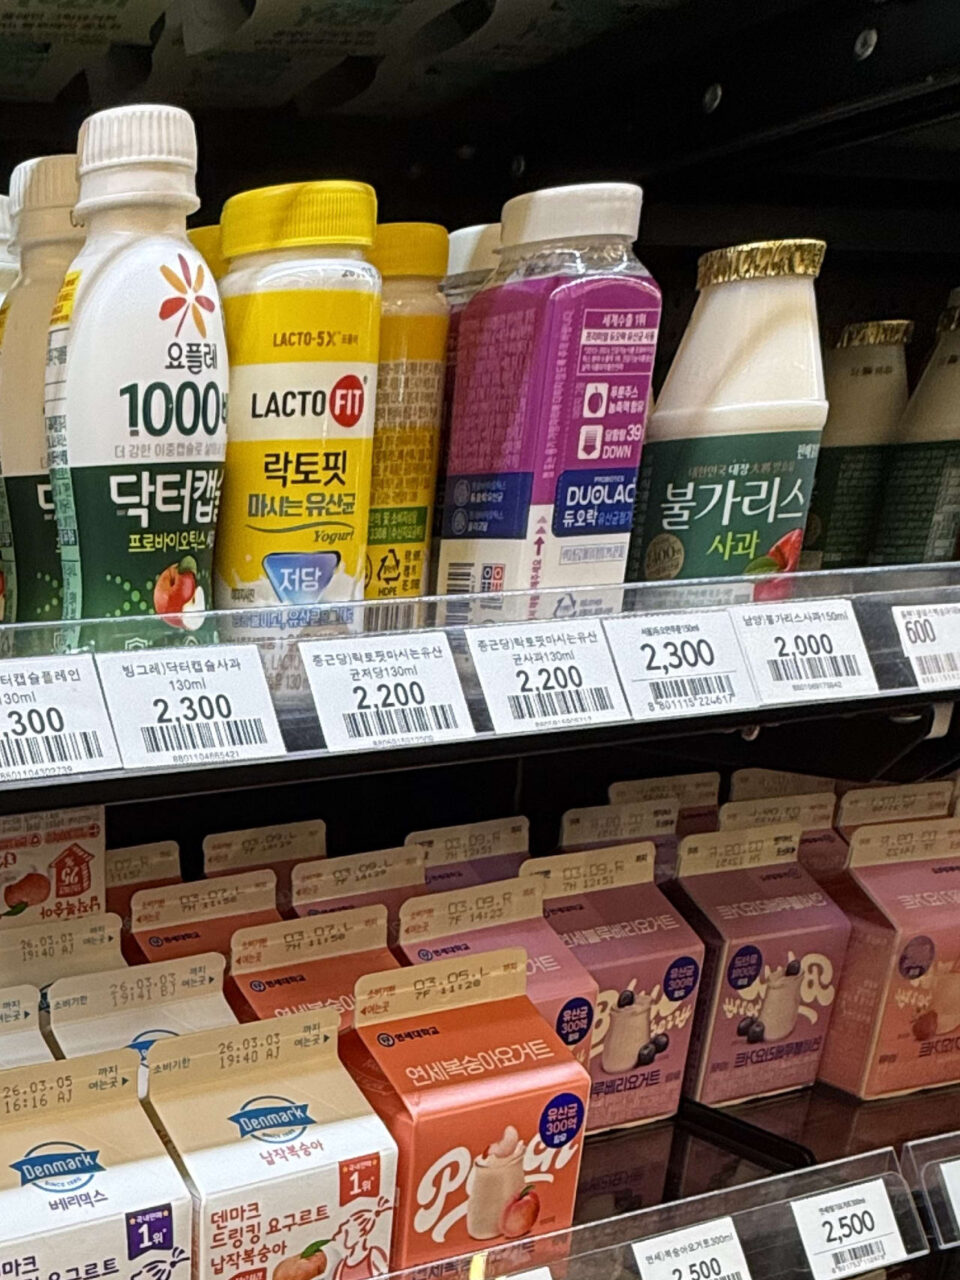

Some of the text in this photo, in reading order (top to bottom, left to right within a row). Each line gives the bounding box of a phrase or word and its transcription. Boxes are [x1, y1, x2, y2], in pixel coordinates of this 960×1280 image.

[165, 342, 218, 375] 요플레
[252, 388, 363, 419] LACTO FIT
[602, 446, 632, 459] DOWN
[264, 450, 348, 488] 락토핏
[248, 492, 356, 518] 마시는 유산균
[660, 476, 805, 530] 불가리스
[563, 508, 598, 528] 듀오락
[706, 529, 760, 561] 사과
[279, 567, 322, 593] 저당
[640, 638, 714, 676] 2,300
[774, 633, 834, 660] 2,000
[122, 657, 241, 679] 빙그레)닥터캡슐사과
[349, 665, 418, 681] 균저당130ml
[515, 665, 583, 694] 2,200
[169, 678, 207, 692] 130ml
[352, 681, 424, 712] 2,200
[153, 694, 232, 726] 2,300
[405, 1039, 555, 1087] 연세복숭아요거트
[2, 1076, 73, 1099] 26.03.05
[240, 1107, 304, 1131] Denmark
[547, 1103, 578, 1123] 유산균
[22, 1153, 94, 1180] Denmark
[48, 1189, 109, 1212] 베리믹스
[210, 1202, 330, 1236] 덴마크 요구르트
[822, 1210, 875, 1244] 2,500
[210, 1223, 261, 1250] 드링킹
[211, 1241, 287, 1275] 납작복숭아
